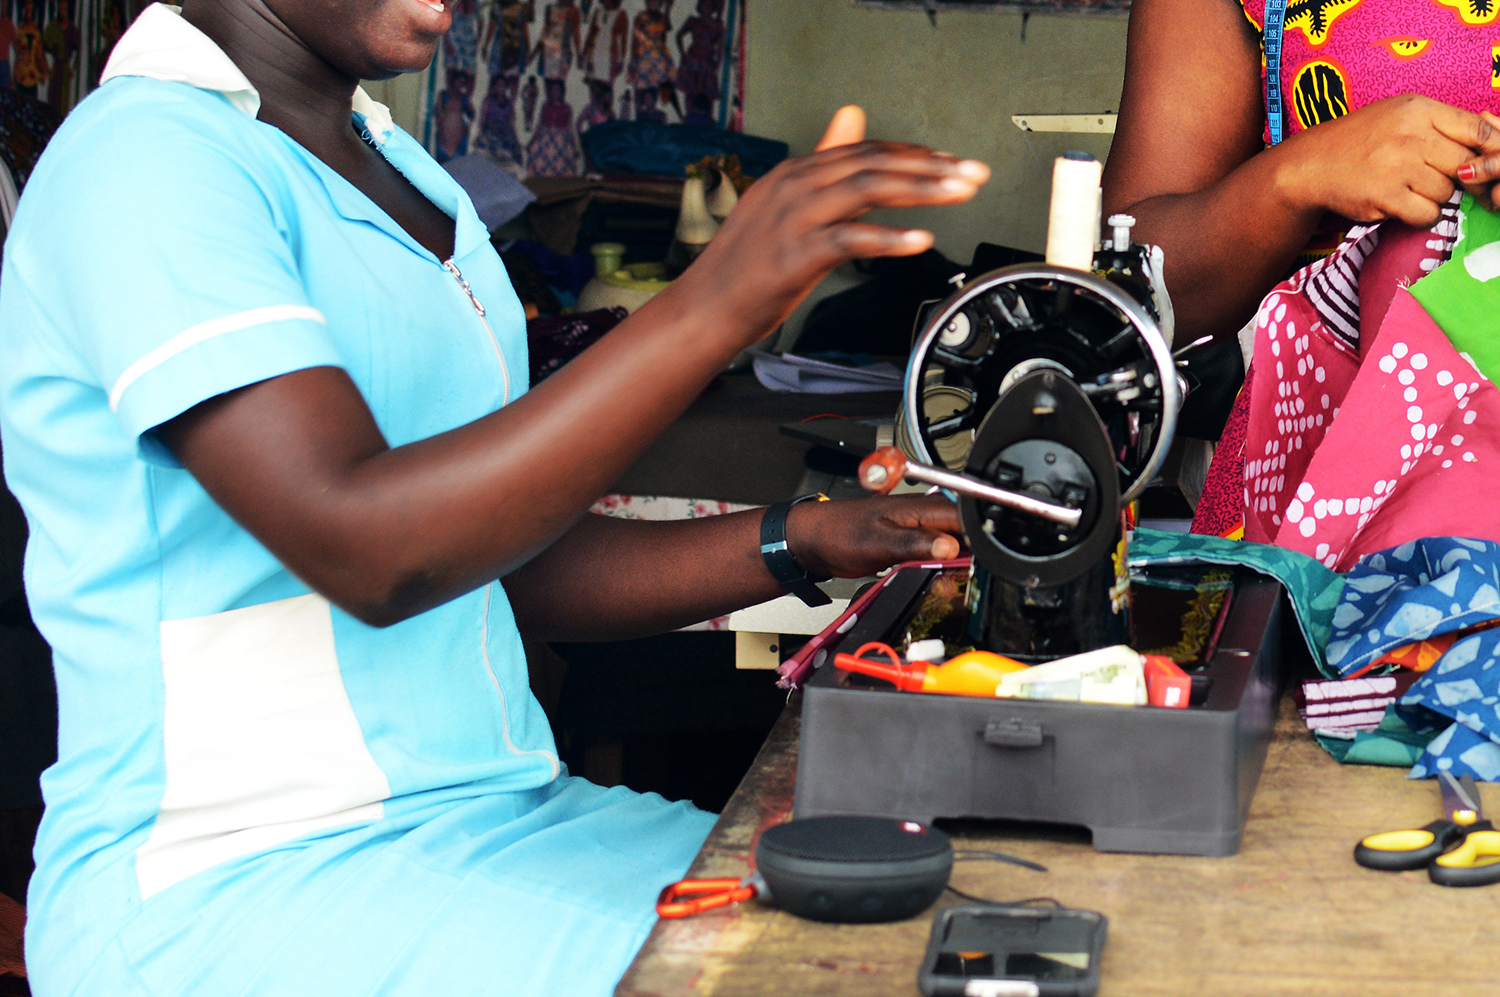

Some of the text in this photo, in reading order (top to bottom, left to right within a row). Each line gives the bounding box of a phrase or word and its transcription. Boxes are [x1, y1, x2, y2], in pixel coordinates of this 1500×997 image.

[1271, 0, 1282, 8] 103
[1269, 14, 1279, 23] 104
[1268, 29, 1277, 38] 105
